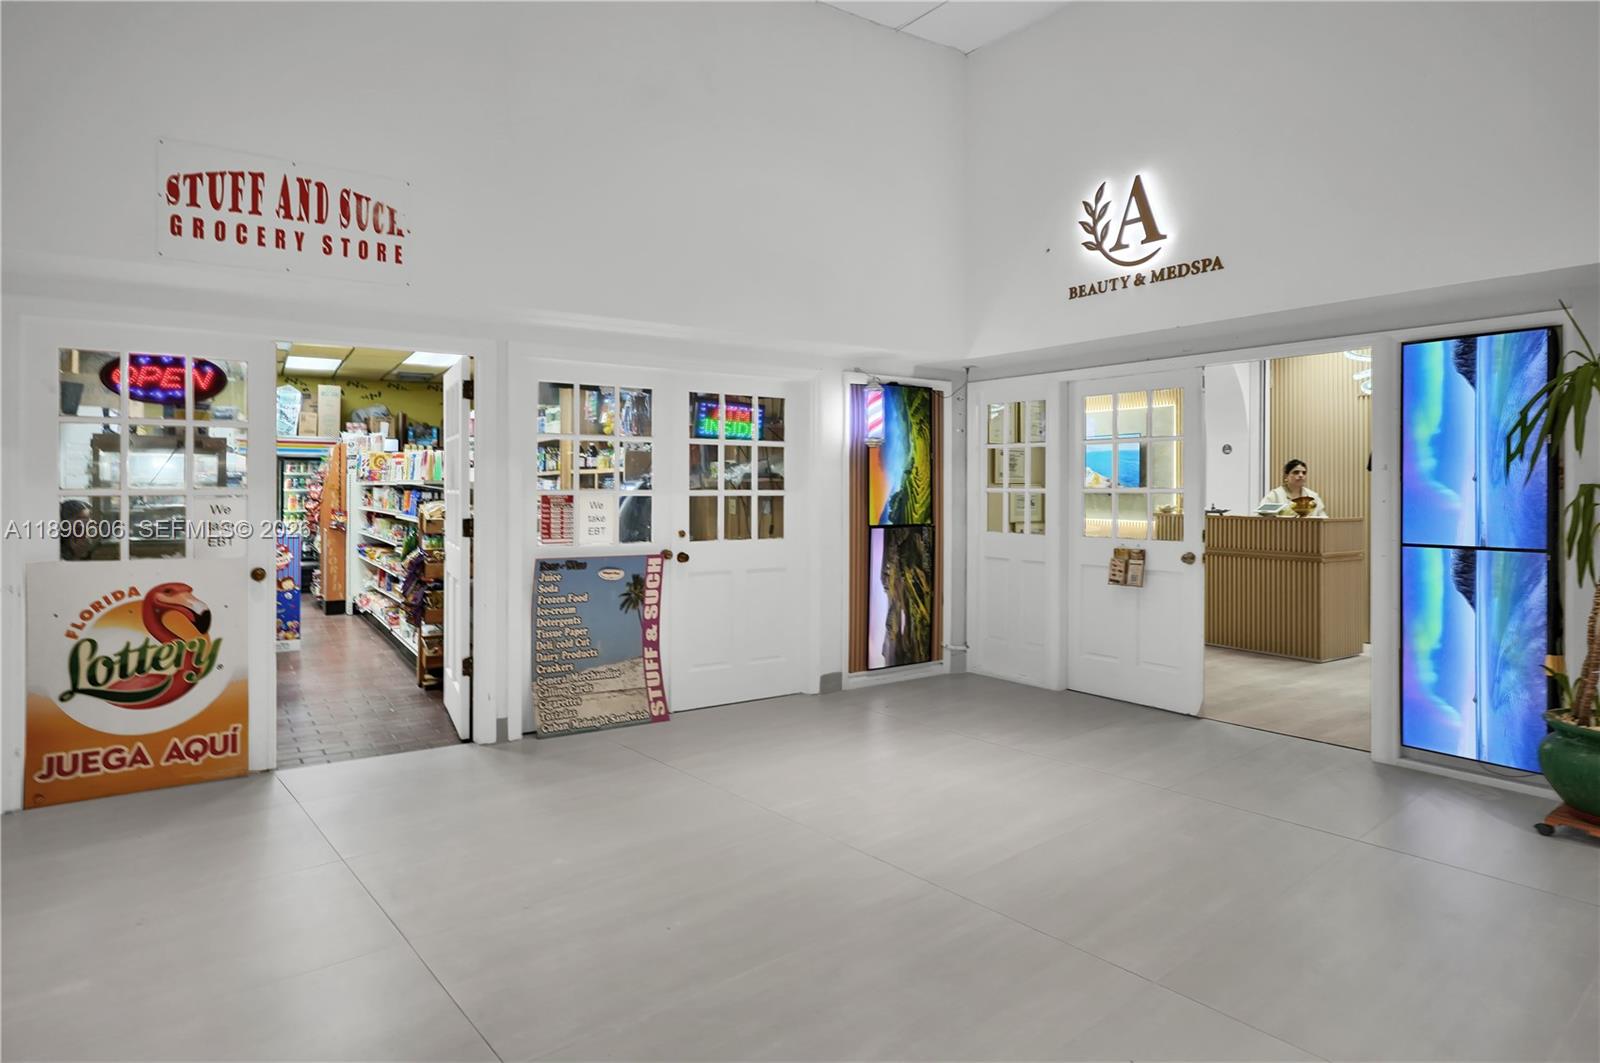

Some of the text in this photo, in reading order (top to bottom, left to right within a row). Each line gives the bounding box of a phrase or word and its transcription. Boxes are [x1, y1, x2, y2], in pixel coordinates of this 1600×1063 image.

[166, 171, 265, 216] STUFF
[276, 174, 329, 224] AND
[1109, 174, 1167, 252] A
[170, 214, 403, 265] GROCERY STORE
[1068, 256, 1224, 300] BEAUTY & MEDSPA
[112, 366, 214, 390] OPEN
[209, 504, 232, 514] We
[589, 501, 604, 510] We
[588, 514, 606, 522] take
[588, 527, 606, 536] EBT
[538, 572, 562, 582] Juice
[538, 583, 559, 593] Soda
[538, 592, 589, 605] Frozen Food
[64, 586, 142, 640] FLORIDA
[537, 616, 582, 627] Detergents
[536, 627, 588, 639] Tissue Paper
[644, 557, 666, 717] STUFF & SUCH
[575, 637, 591, 647] Cut
[536, 648, 598, 663] Dairy Products
[59, 636, 222, 703] Lottery
[536, 664, 574, 674] Crackers
[537, 675, 567, 686] General
[542, 710, 650, 733] Cuban Midnight Sandwich
[35, 726, 241, 782] JUEGA AQUÍ
